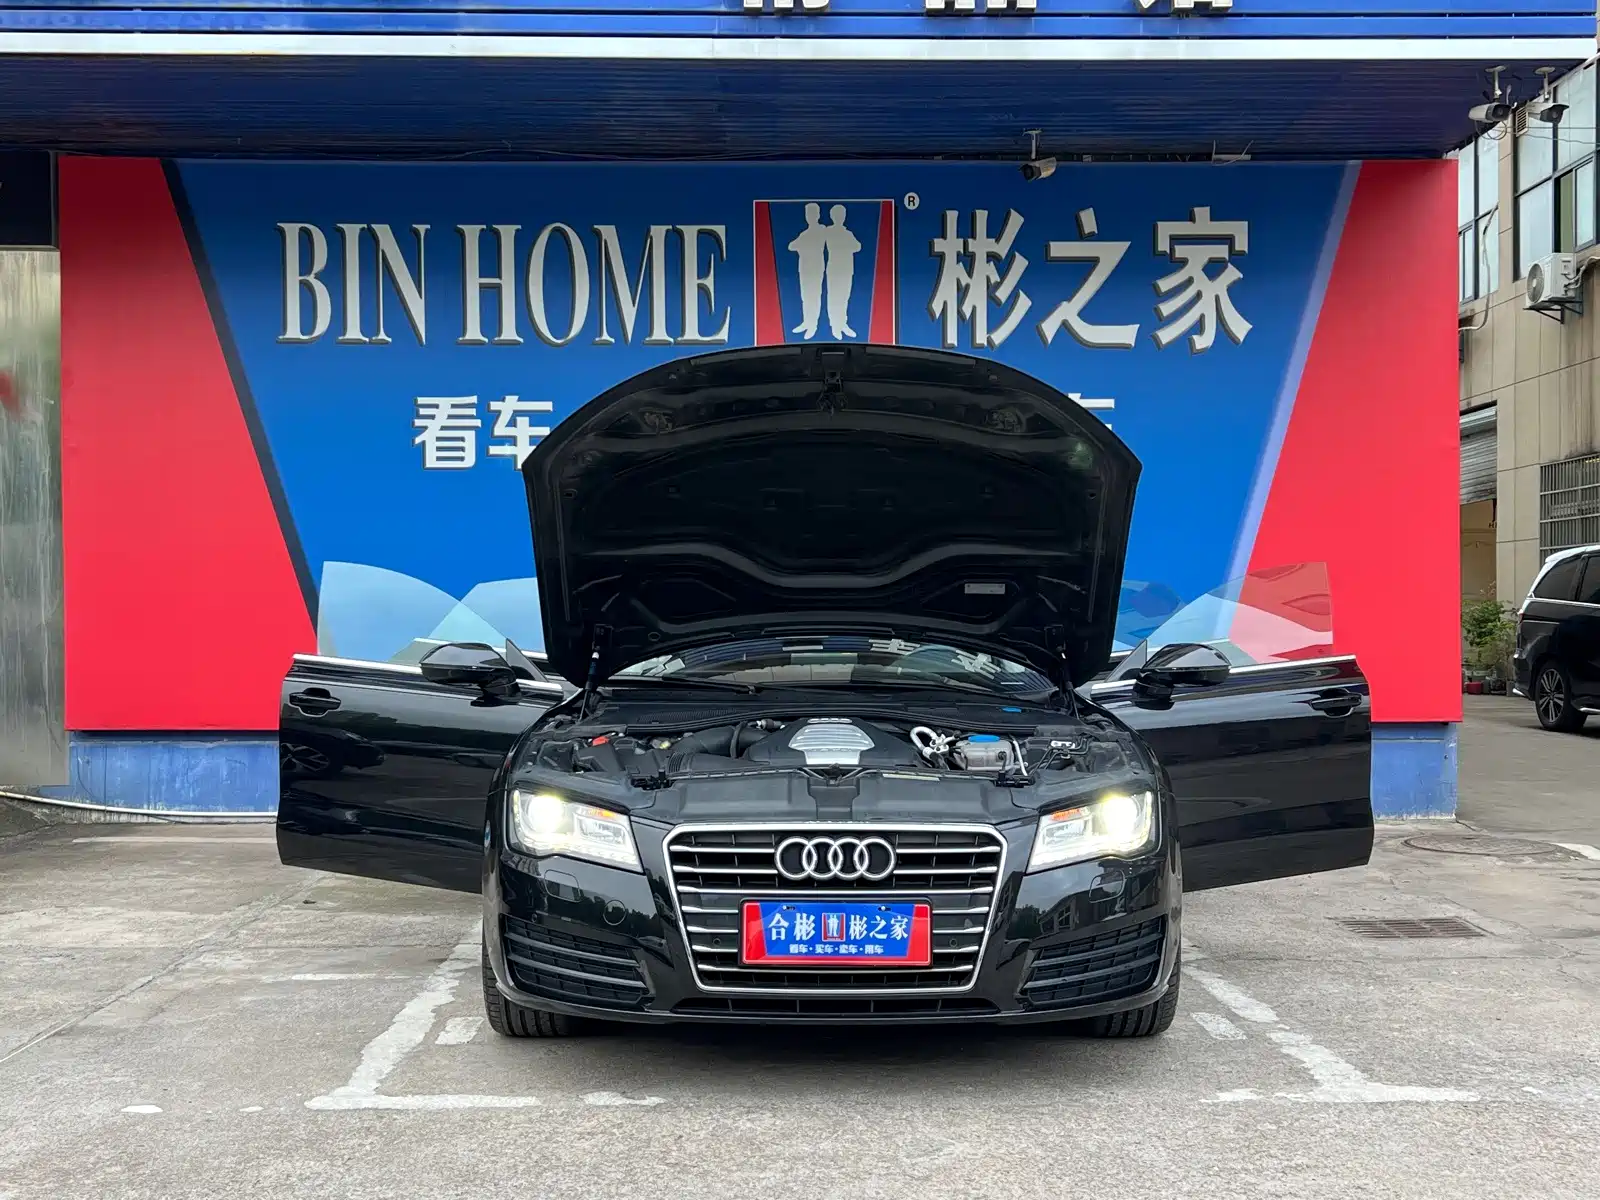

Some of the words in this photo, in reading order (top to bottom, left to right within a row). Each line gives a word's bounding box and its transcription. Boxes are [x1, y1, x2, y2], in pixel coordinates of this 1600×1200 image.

[277, 222, 430, 345] BIN
[457, 222, 731, 345] HOME
[929, 206, 1253, 352] 彬之家
[413, 395, 553, 469] 看车
[768, 912, 816, 941] 合彬
[848, 914, 909, 941] 彬之家
